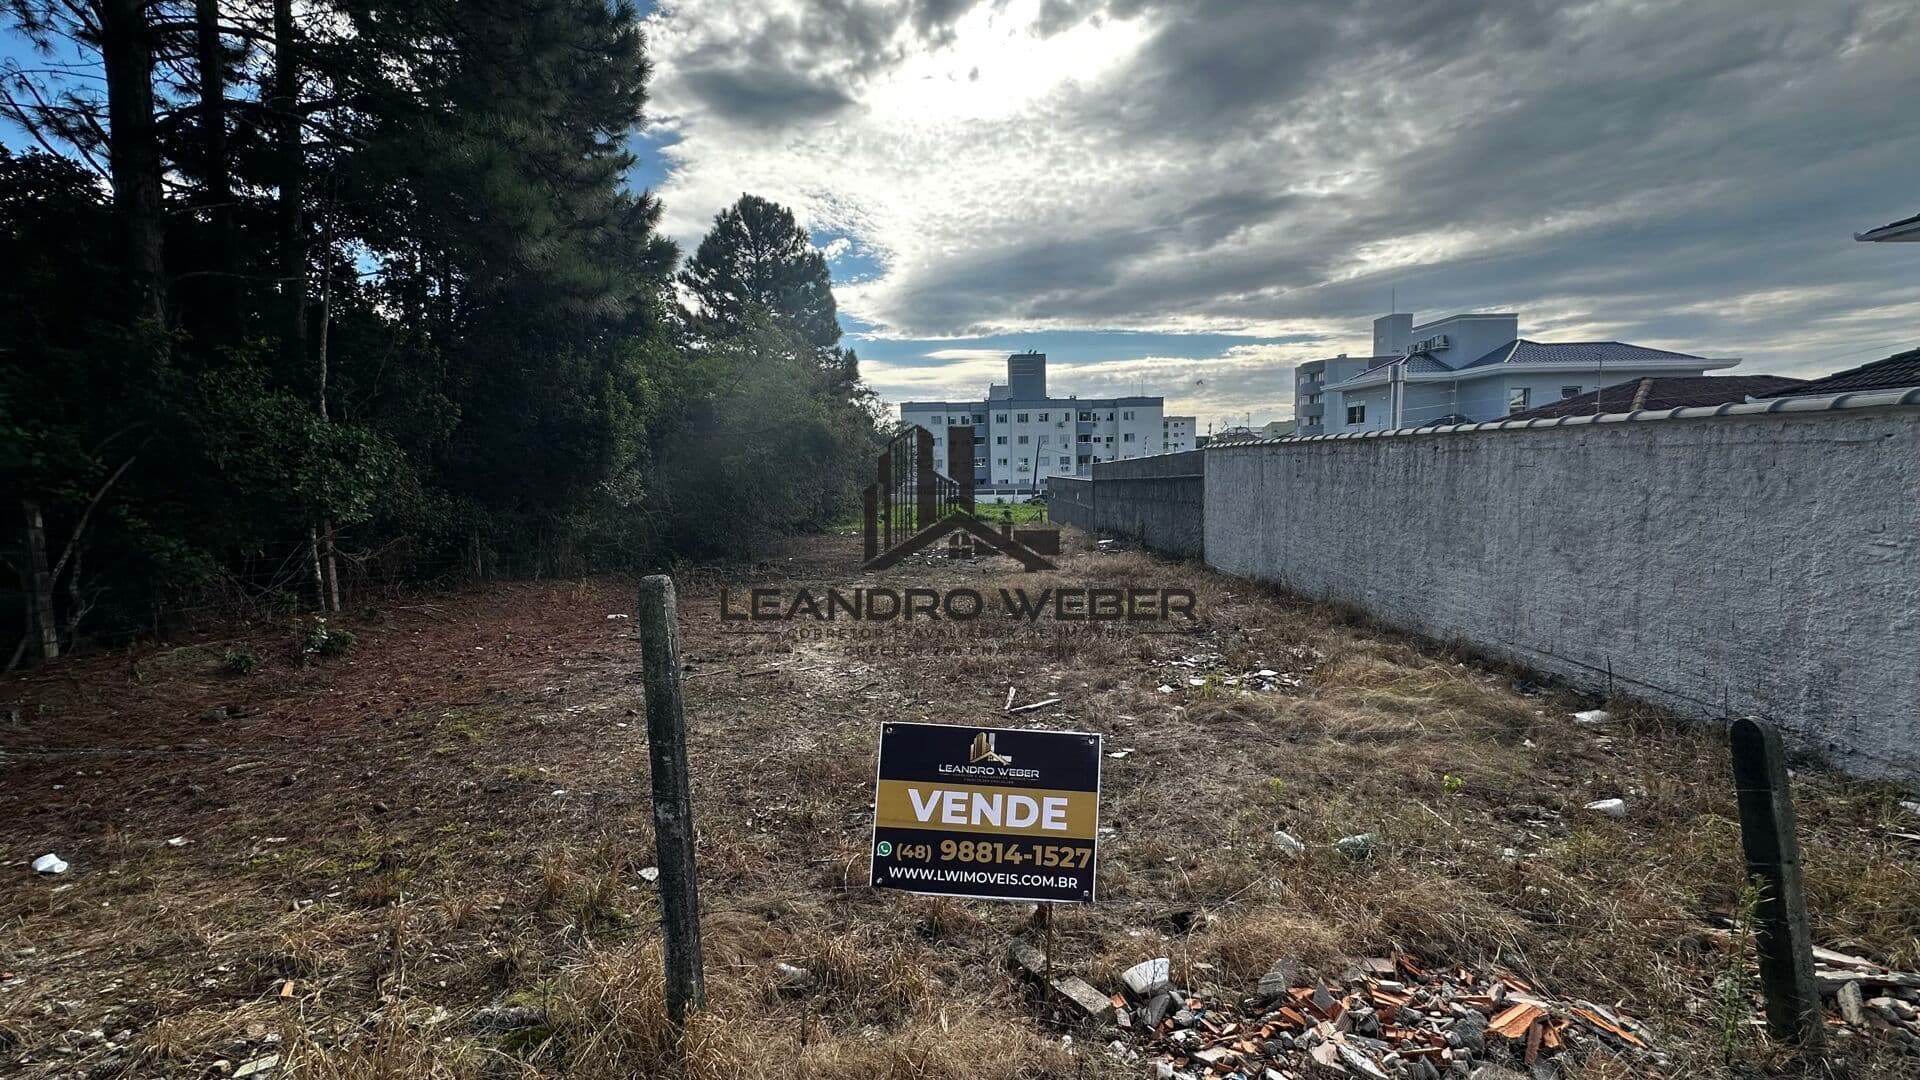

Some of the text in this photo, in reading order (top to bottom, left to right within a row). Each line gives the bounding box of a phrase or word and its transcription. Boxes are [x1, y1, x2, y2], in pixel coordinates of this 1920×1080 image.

[938, 764, 995, 775] LEANDRO
[997, 767, 1040, 778] WEBER
[908, 788, 1068, 830] VENDE
[896, 839, 1092, 869] (48) 98814-1527
[888, 866, 1078, 889] WWW.LWIMOVEIS.COM.BR
